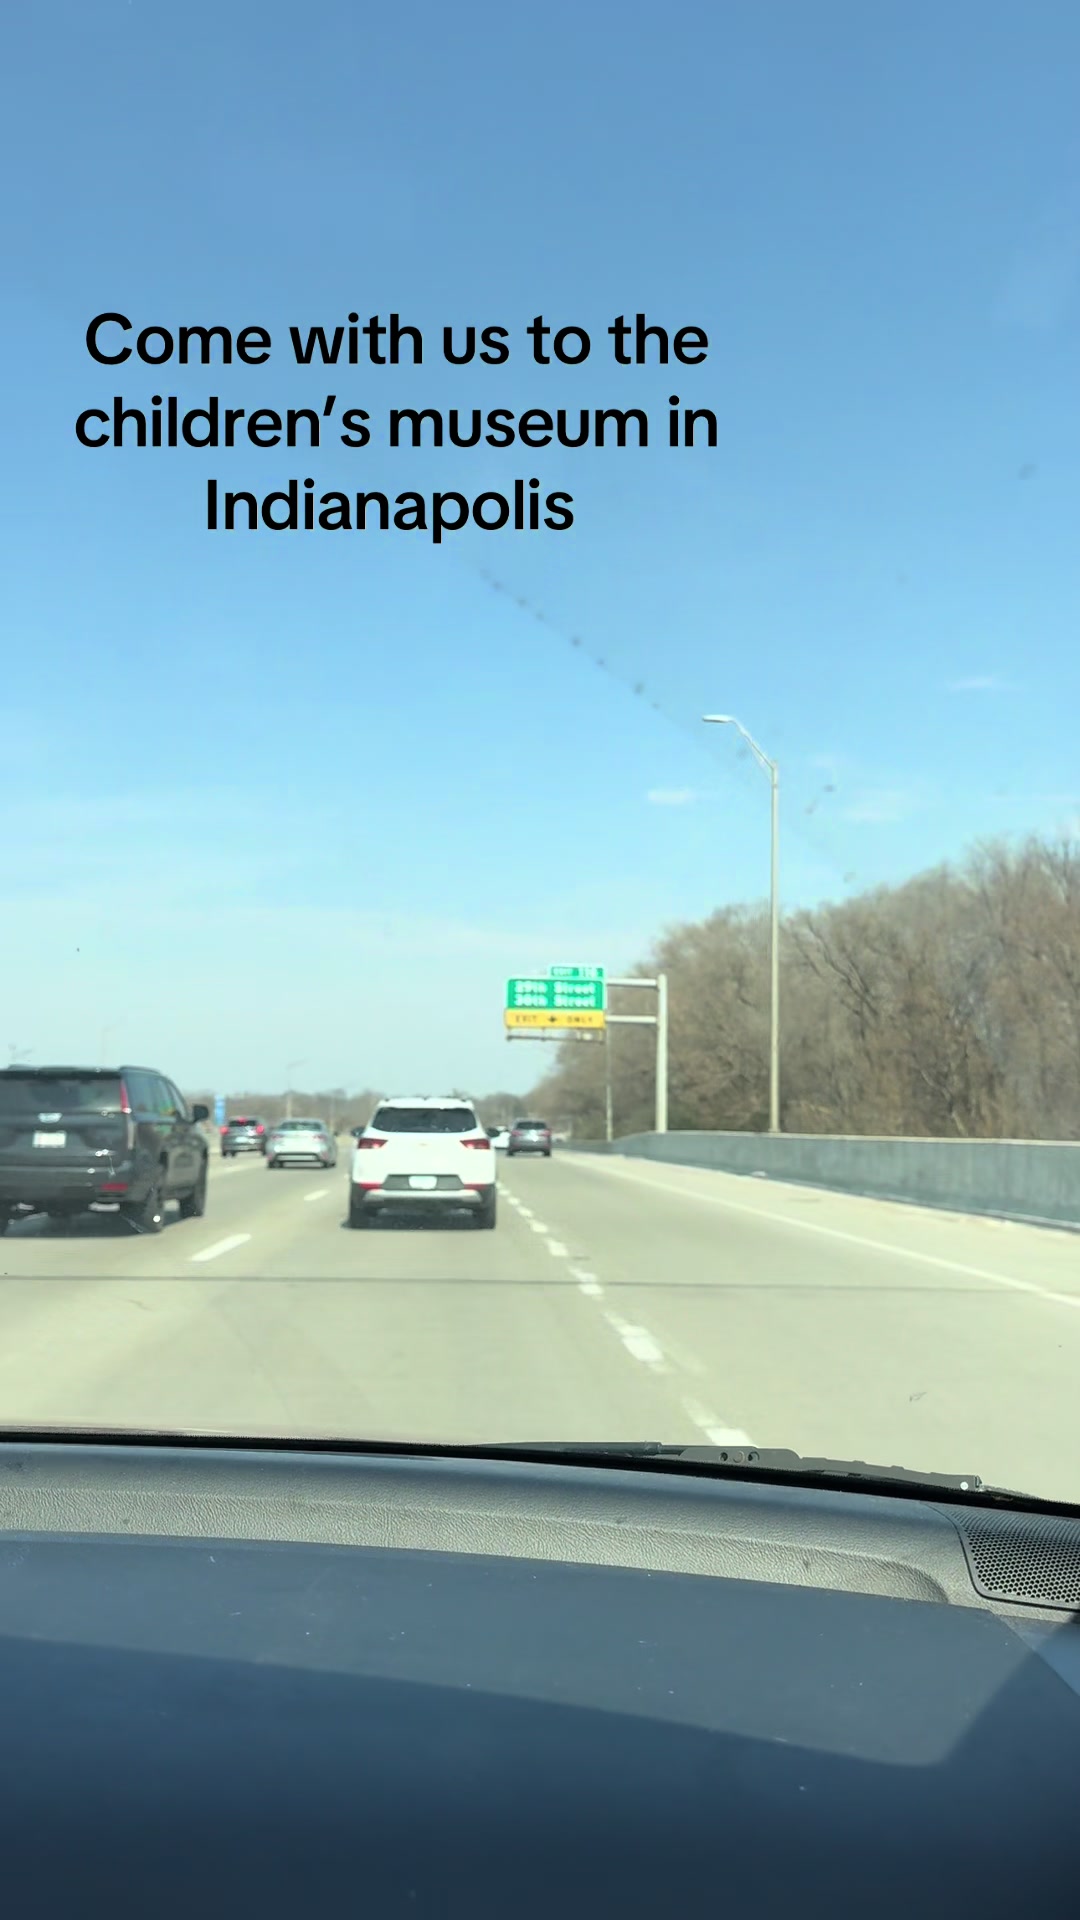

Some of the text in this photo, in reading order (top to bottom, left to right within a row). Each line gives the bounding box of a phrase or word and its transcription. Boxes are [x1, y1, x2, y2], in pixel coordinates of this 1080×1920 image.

[553, 981, 595, 994] Street
[553, 993, 595, 1007] Street
[515, 1014, 593, 1024] EXIT ONLY
